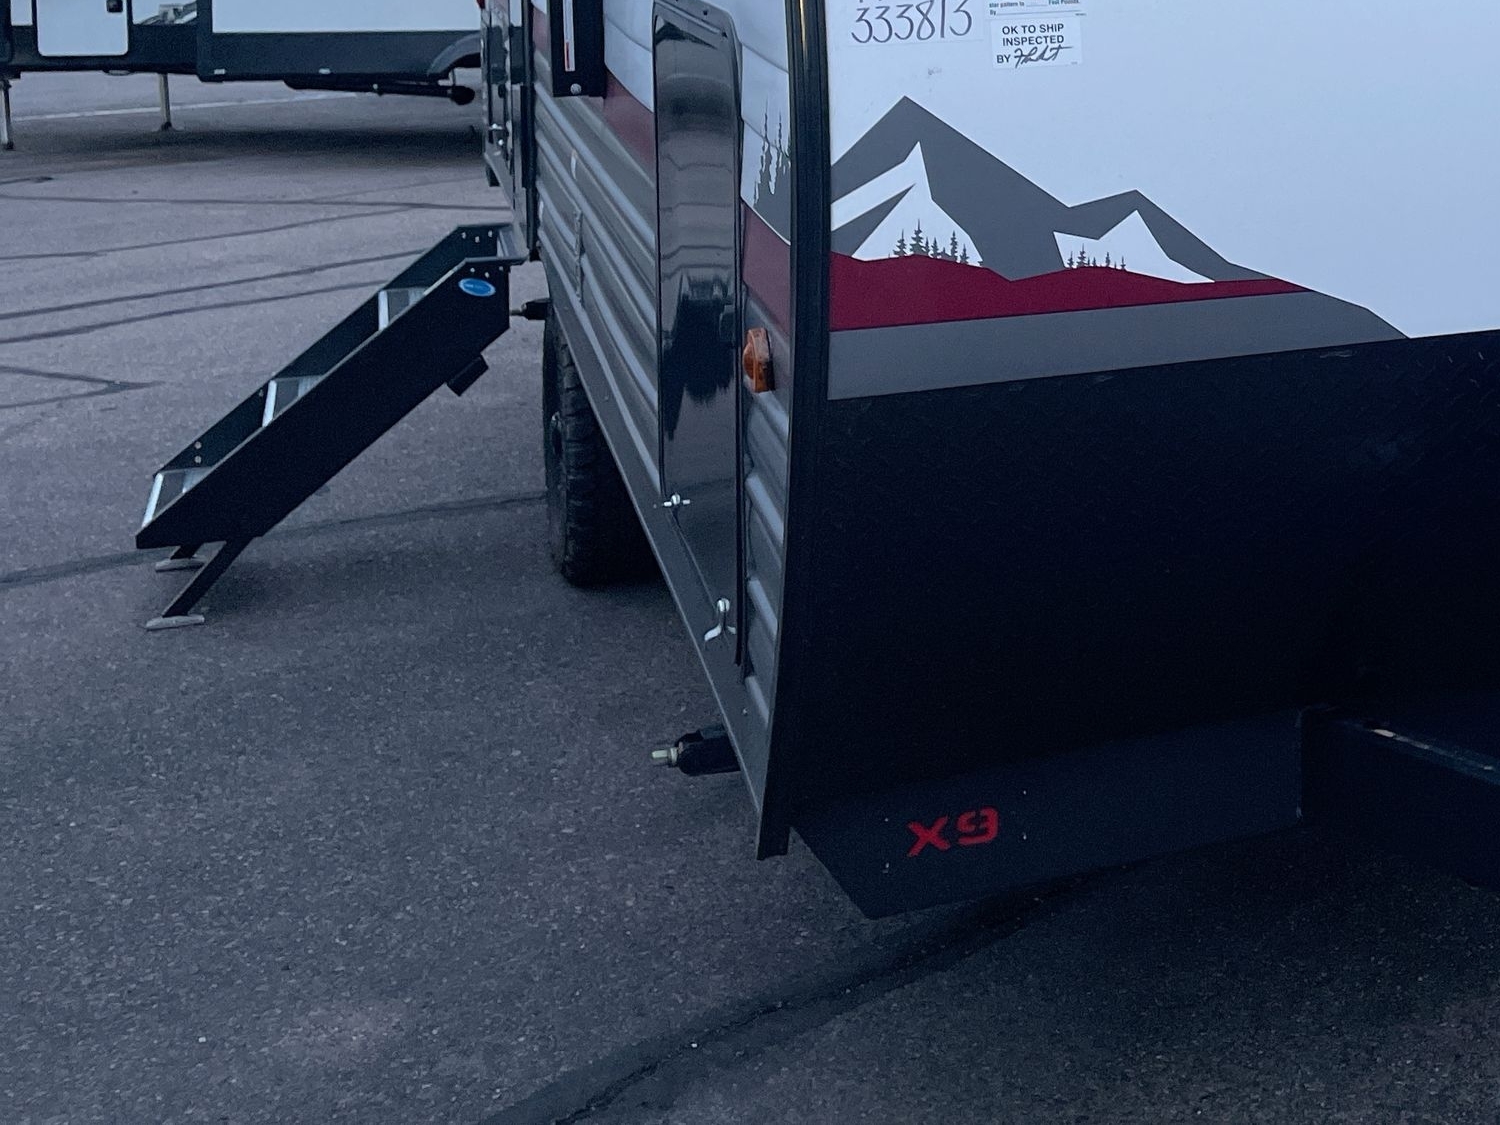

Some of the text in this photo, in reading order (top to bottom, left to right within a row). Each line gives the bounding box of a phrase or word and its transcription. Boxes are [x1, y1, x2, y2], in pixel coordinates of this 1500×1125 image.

[1002, 23, 1064, 35] OK TO SHIP
[1002, 35, 1064, 46] INSPECTED
[996, 54, 1011, 63] BY
[907, 806, 999, 857] X9
